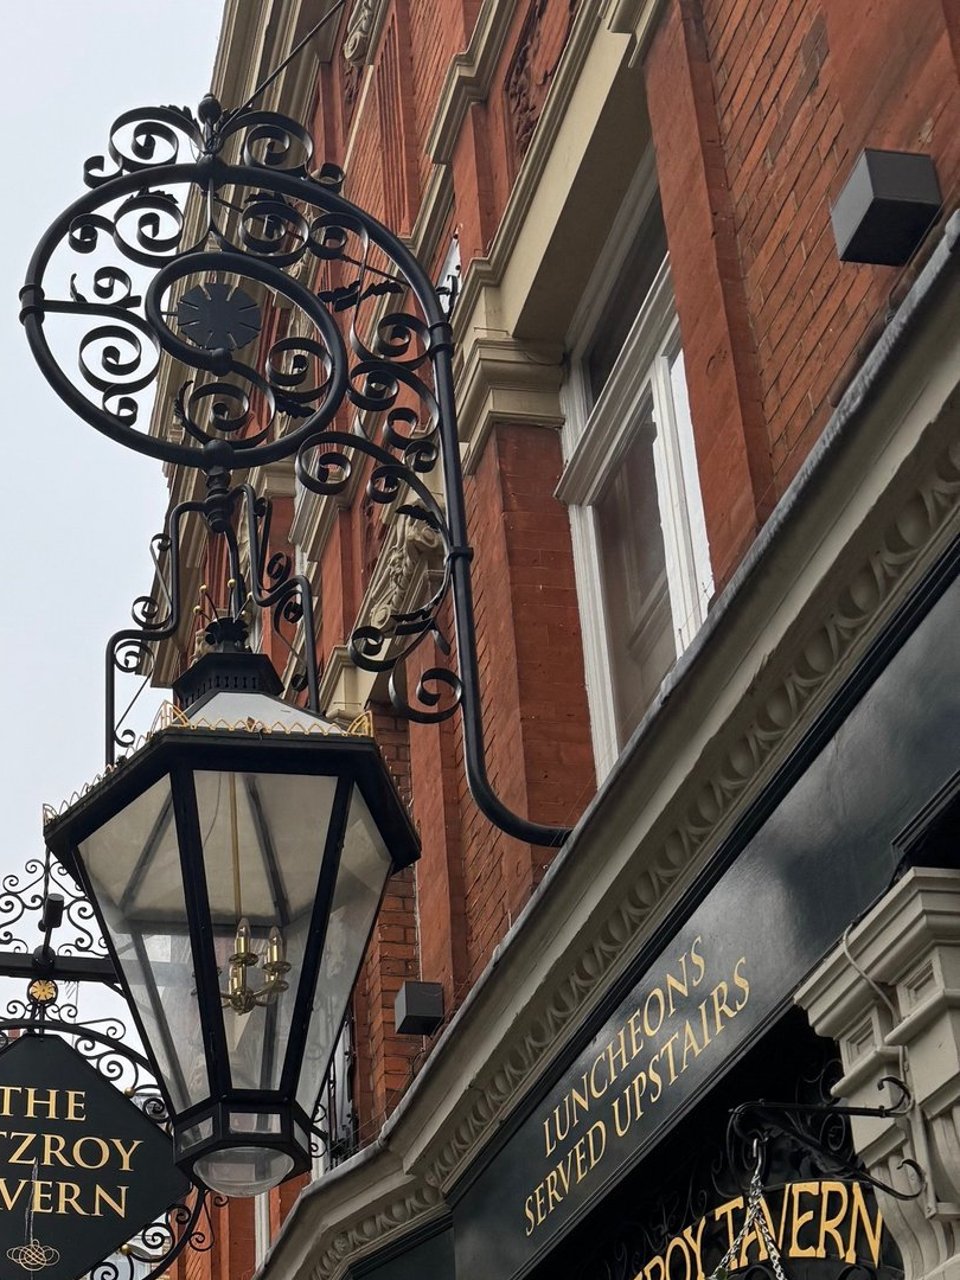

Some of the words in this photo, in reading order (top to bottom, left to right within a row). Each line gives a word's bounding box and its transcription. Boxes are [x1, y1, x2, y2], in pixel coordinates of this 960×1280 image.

[524, 1120, 607, 1237] SERVED
[611, 957, 751, 1139] UPSTAIRS
[543, 935, 706, 1158] LUNCHEONS
[714, 1181, 883, 1271] TAVERN
